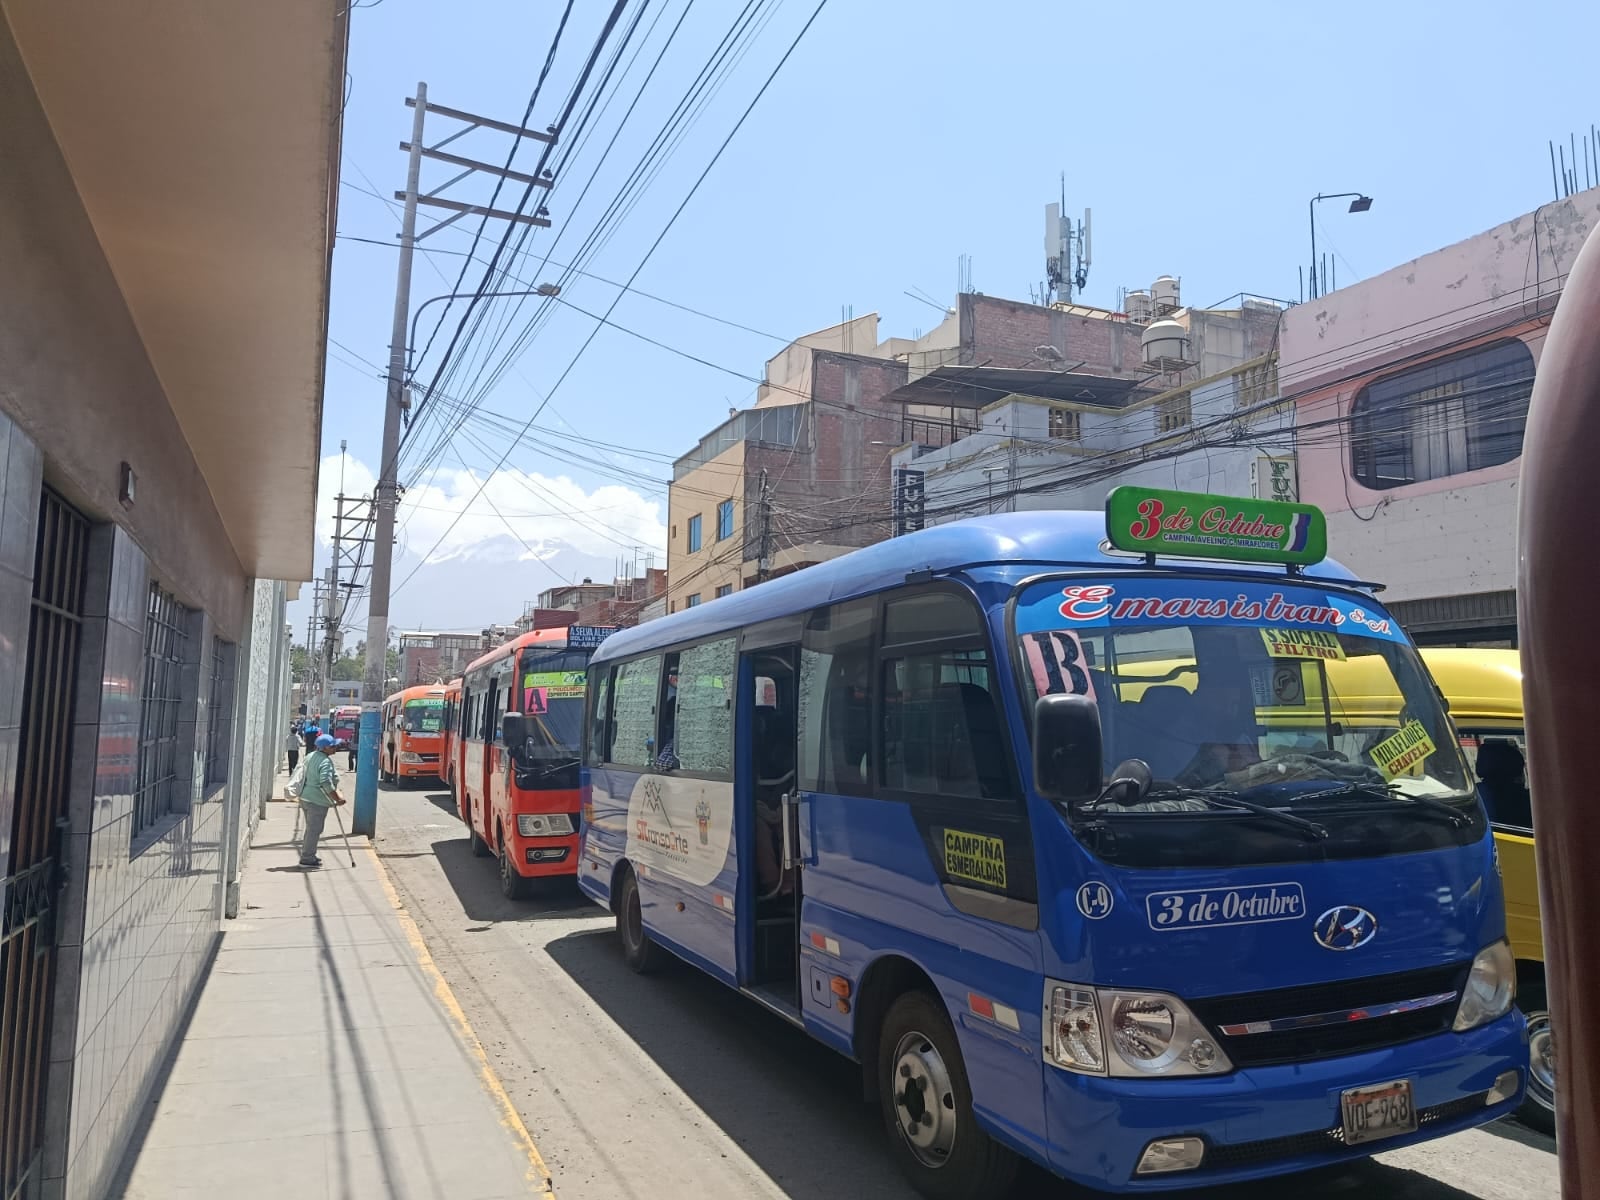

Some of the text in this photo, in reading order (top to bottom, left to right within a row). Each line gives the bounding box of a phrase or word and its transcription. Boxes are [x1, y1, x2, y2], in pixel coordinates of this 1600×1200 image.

[903, 475, 919, 535] FUNE
[1130, 499, 1286, 541] 3 de Octubre
[1197, 536, 1227, 546] AVELINO
[1237, 538, 1279, 549] MIRAFLORES
[1032, 631, 1089, 695] B
[1272, 643, 1339, 660] FILTRO
[528, 688, 546, 712] A
[1373, 722, 1427, 767] MIRAFLORES
[1388, 741, 1430, 775] CHAVELA
[946, 833, 1003, 862] CAMPIÑA
[947, 852, 1005, 885] ESMERALDAS
[1082, 886, 1108, 914] C-9
[1157, 889, 1299, 924] 3 de Octubre
